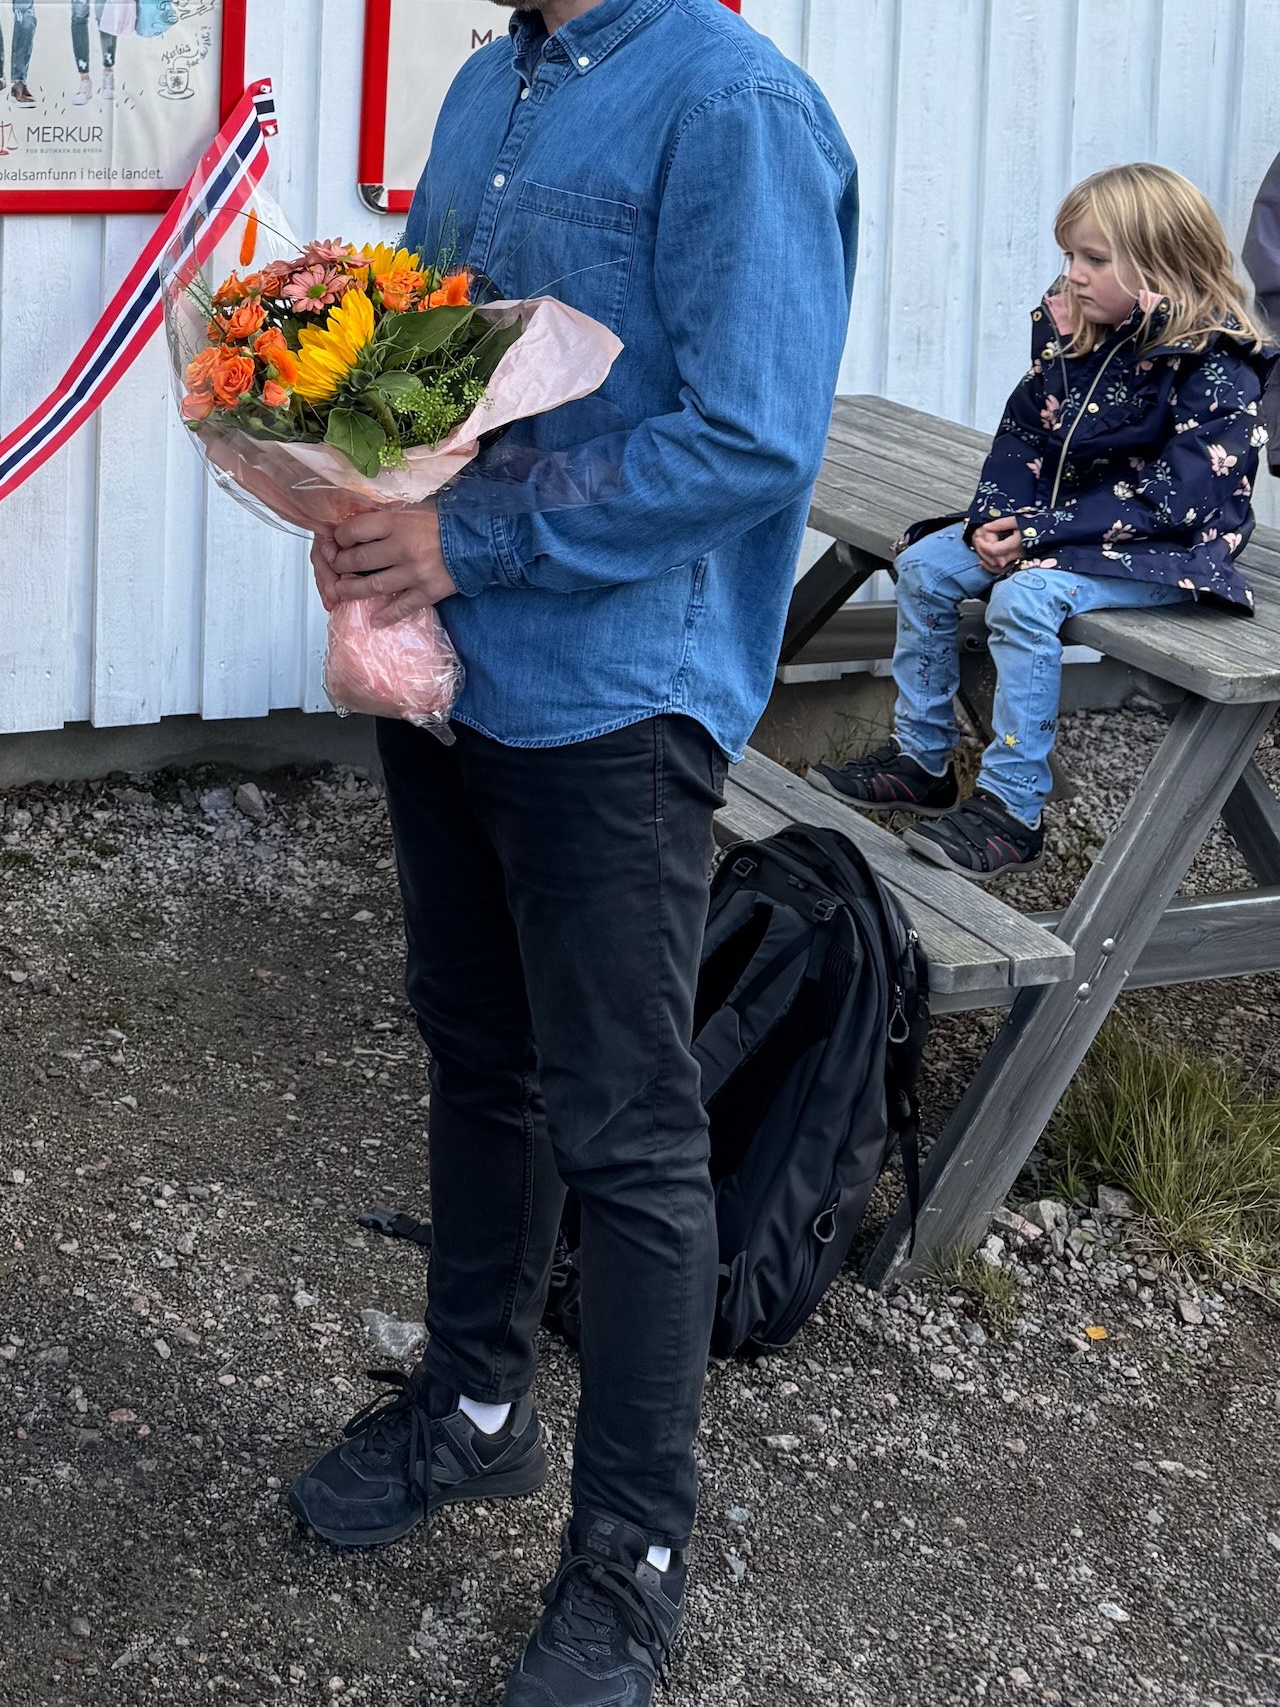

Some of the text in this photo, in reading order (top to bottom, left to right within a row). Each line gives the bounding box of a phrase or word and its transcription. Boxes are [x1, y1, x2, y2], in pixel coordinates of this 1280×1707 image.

[26, 126, 104, 143] MERKUR
[80, 167, 84, 180] i
[87, 166, 118, 181] heile
[121, 165, 164, 181] landet.
